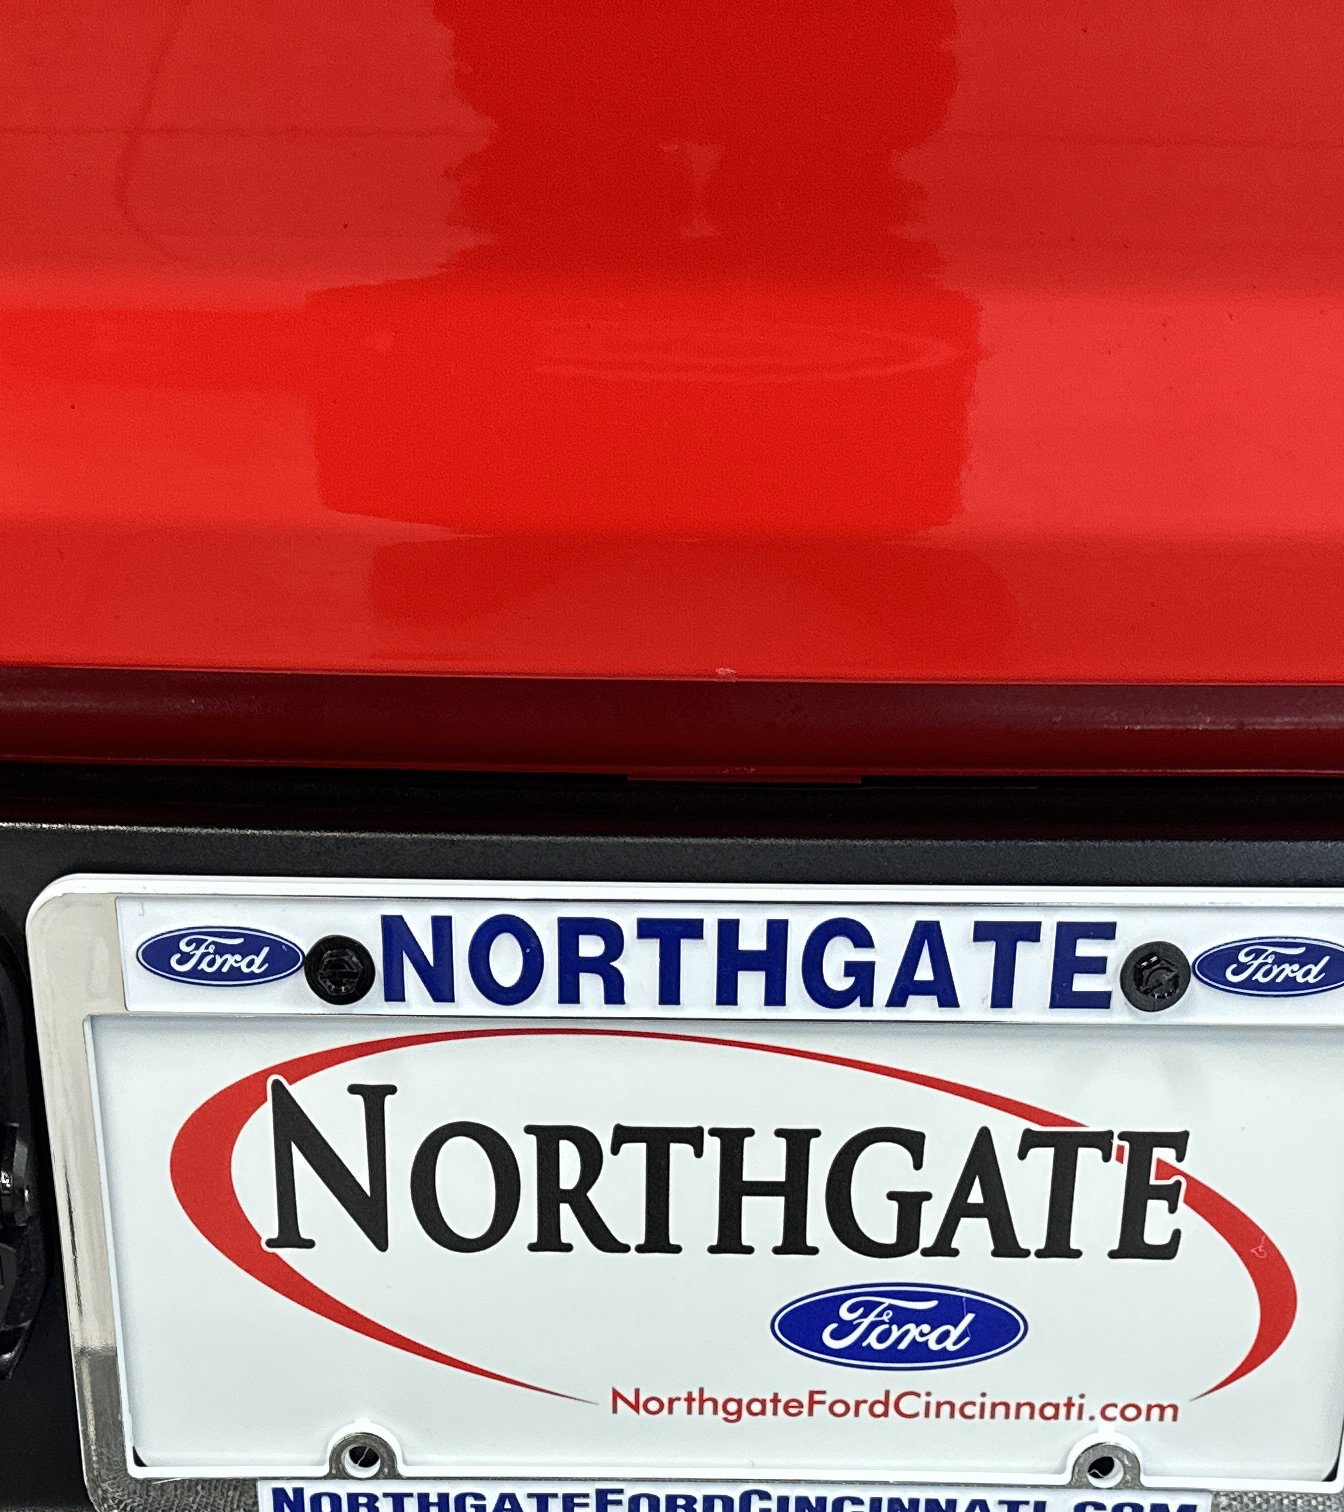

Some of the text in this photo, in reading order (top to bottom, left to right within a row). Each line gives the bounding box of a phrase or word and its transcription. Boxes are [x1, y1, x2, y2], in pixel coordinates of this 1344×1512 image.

[168, 933, 269, 976] Ford
[380, 913, 1118, 1010] NORTHGATE
[1224, 945, 1329, 985] Ford
[266, 1079, 1191, 1260] NORTHGATE
[820, 1294, 973, 1352] Ford
[612, 1387, 1179, 1424] NorthgateFordCincinnati.com
